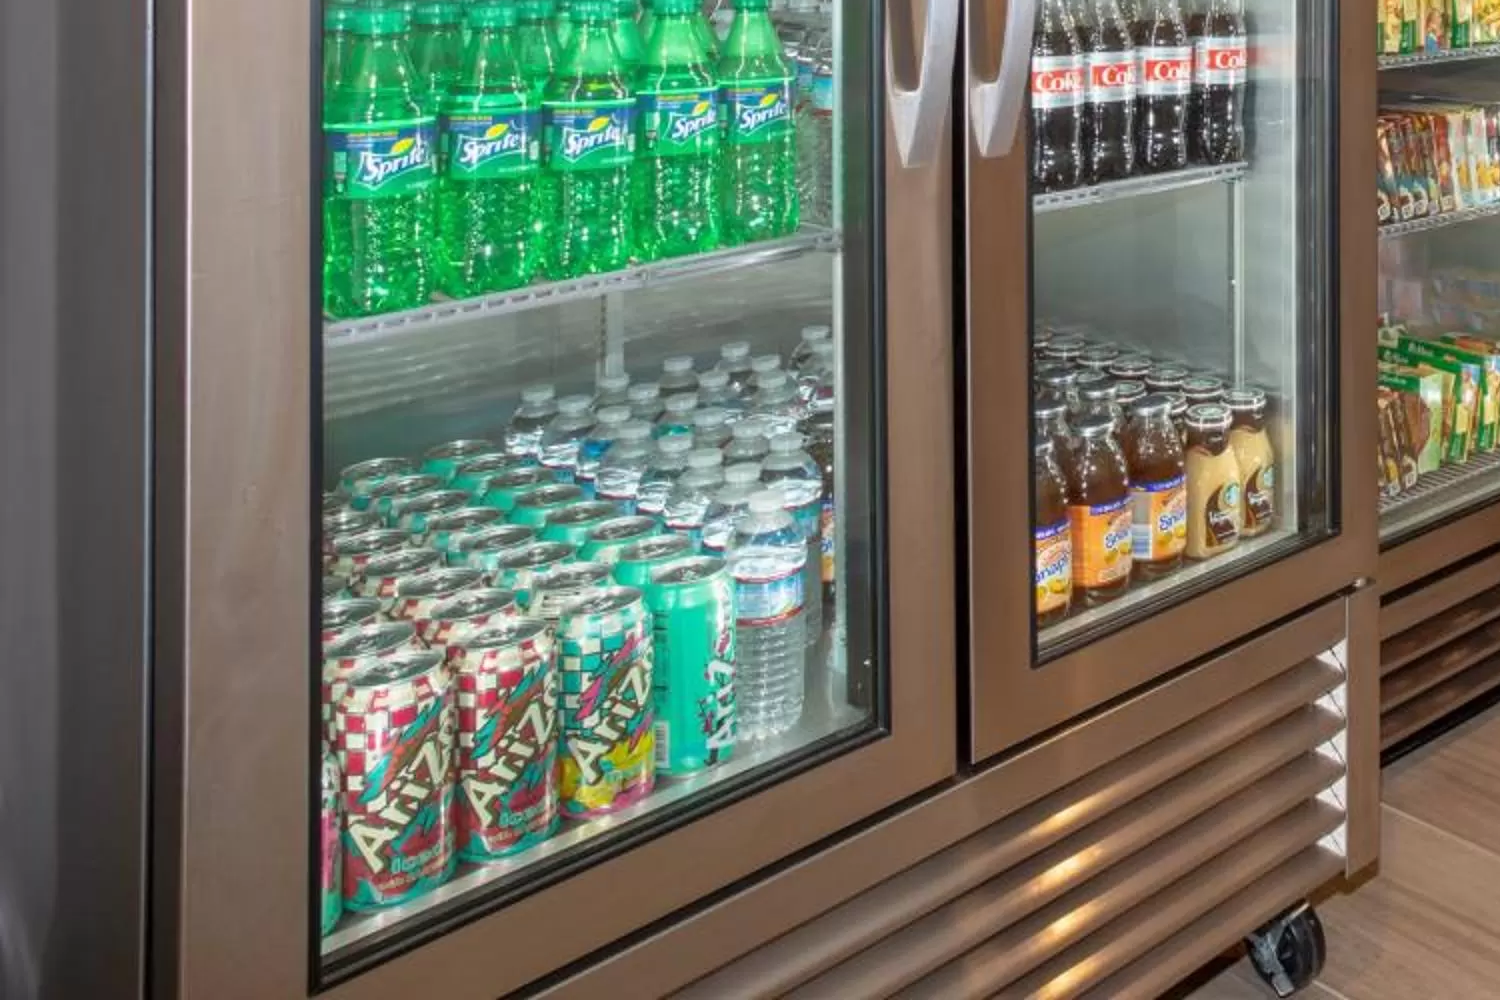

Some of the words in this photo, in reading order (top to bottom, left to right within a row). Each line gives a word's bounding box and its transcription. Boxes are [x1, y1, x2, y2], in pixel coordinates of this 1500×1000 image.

[738, 101, 788, 132] Sprite
[460, 131, 522, 167] Sprite
[563, 122, 622, 157] Sprite
[361, 144, 426, 184] Sprite
